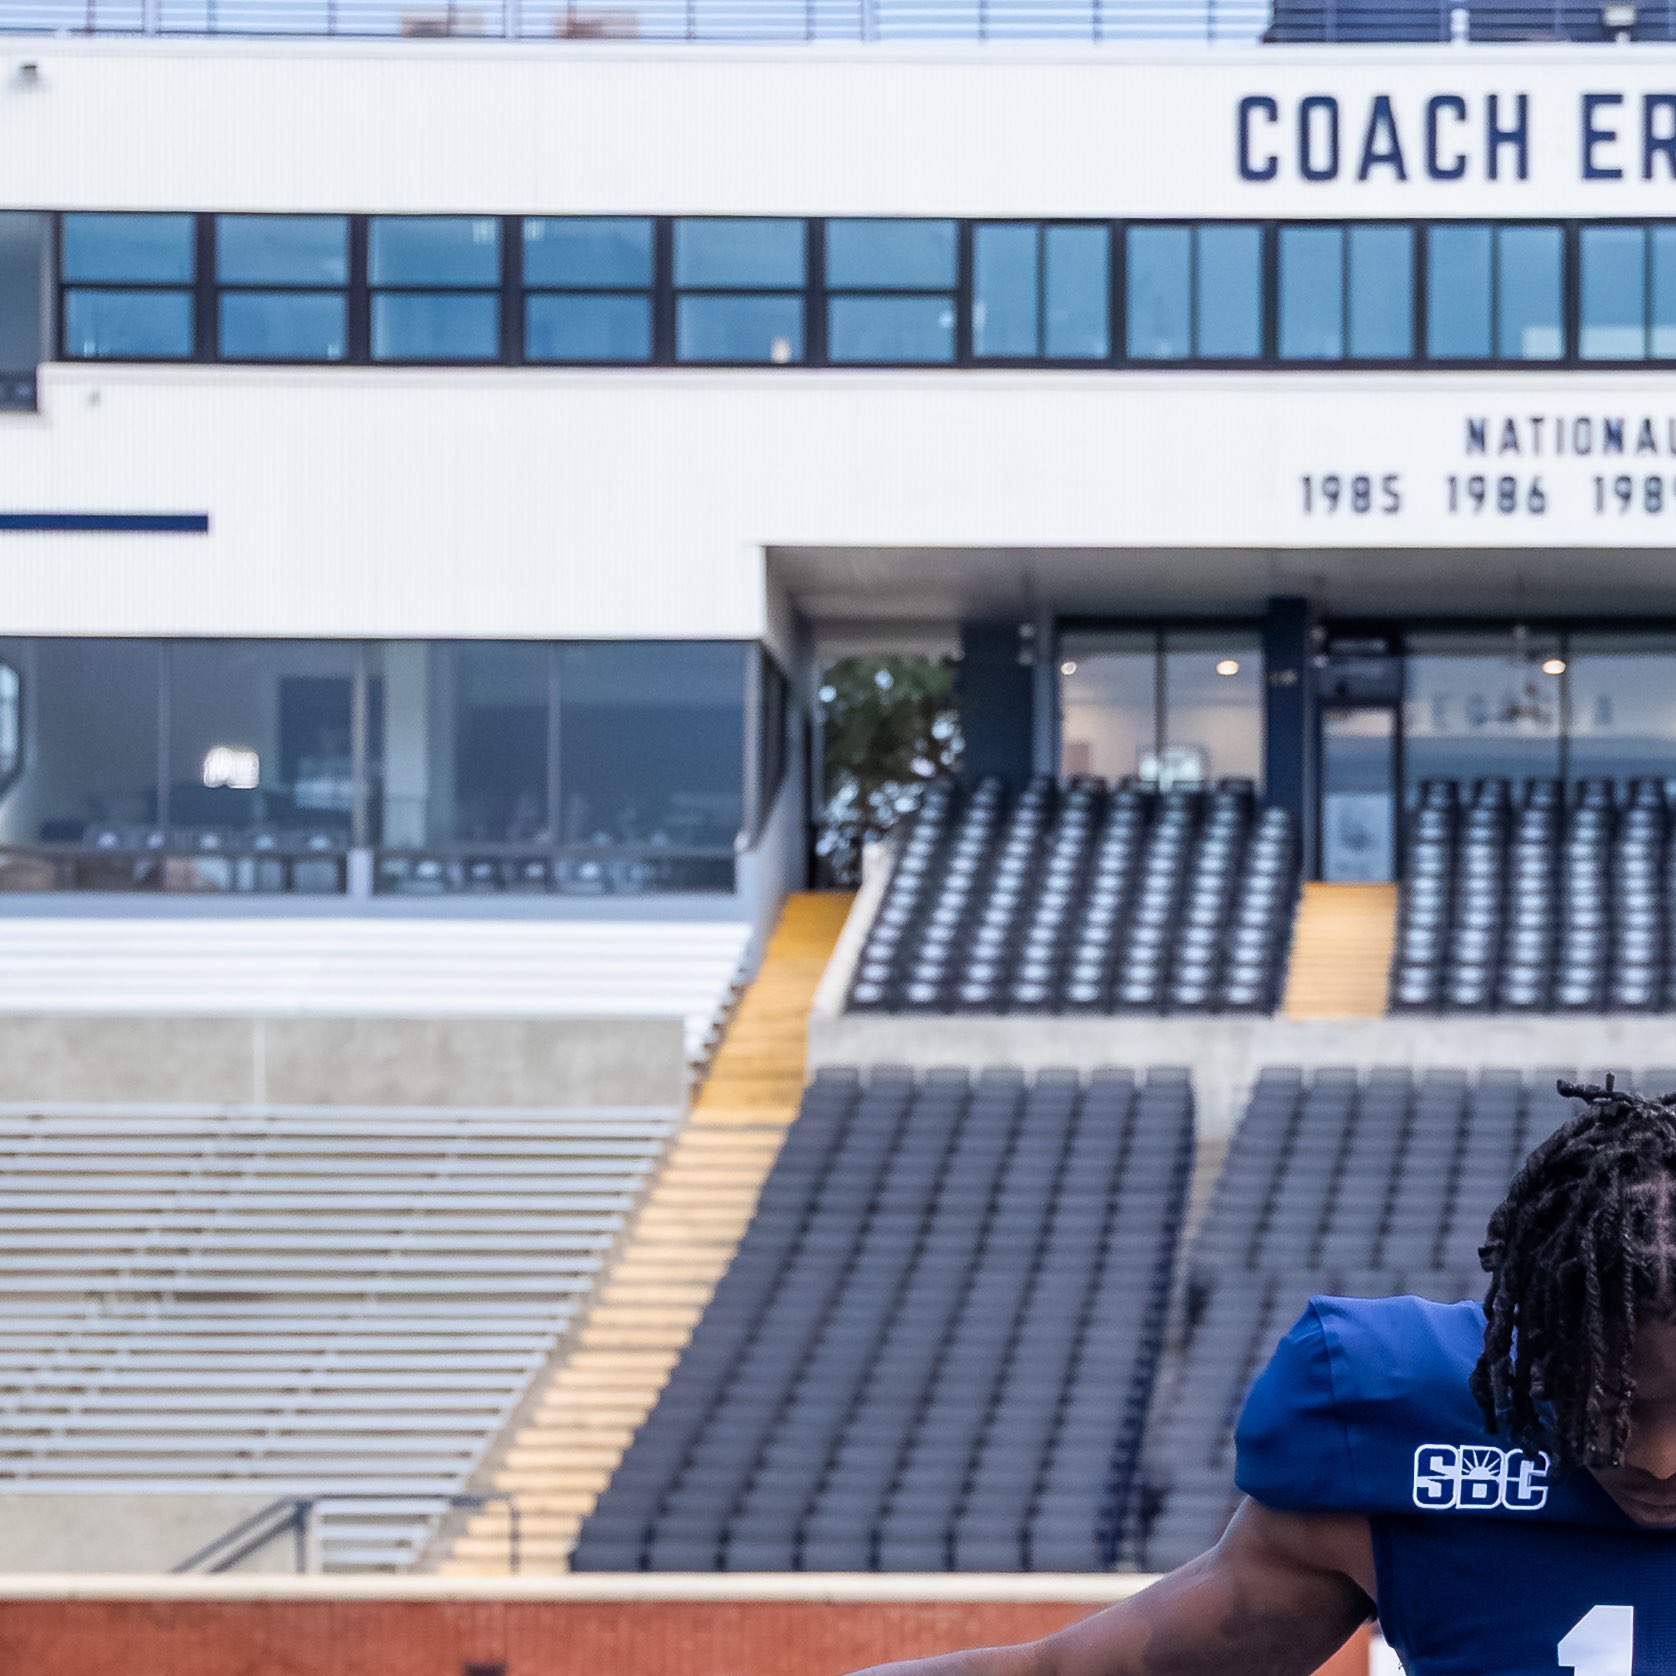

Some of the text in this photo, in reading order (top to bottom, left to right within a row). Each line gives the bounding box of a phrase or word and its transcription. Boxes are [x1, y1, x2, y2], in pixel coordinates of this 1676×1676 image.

[1236, 93, 1529, 183] COACH
[1300, 473, 1402, 515] 1985
[1446, 473, 1548, 516] 1986
[1413, 1444, 1549, 1510] SBC
